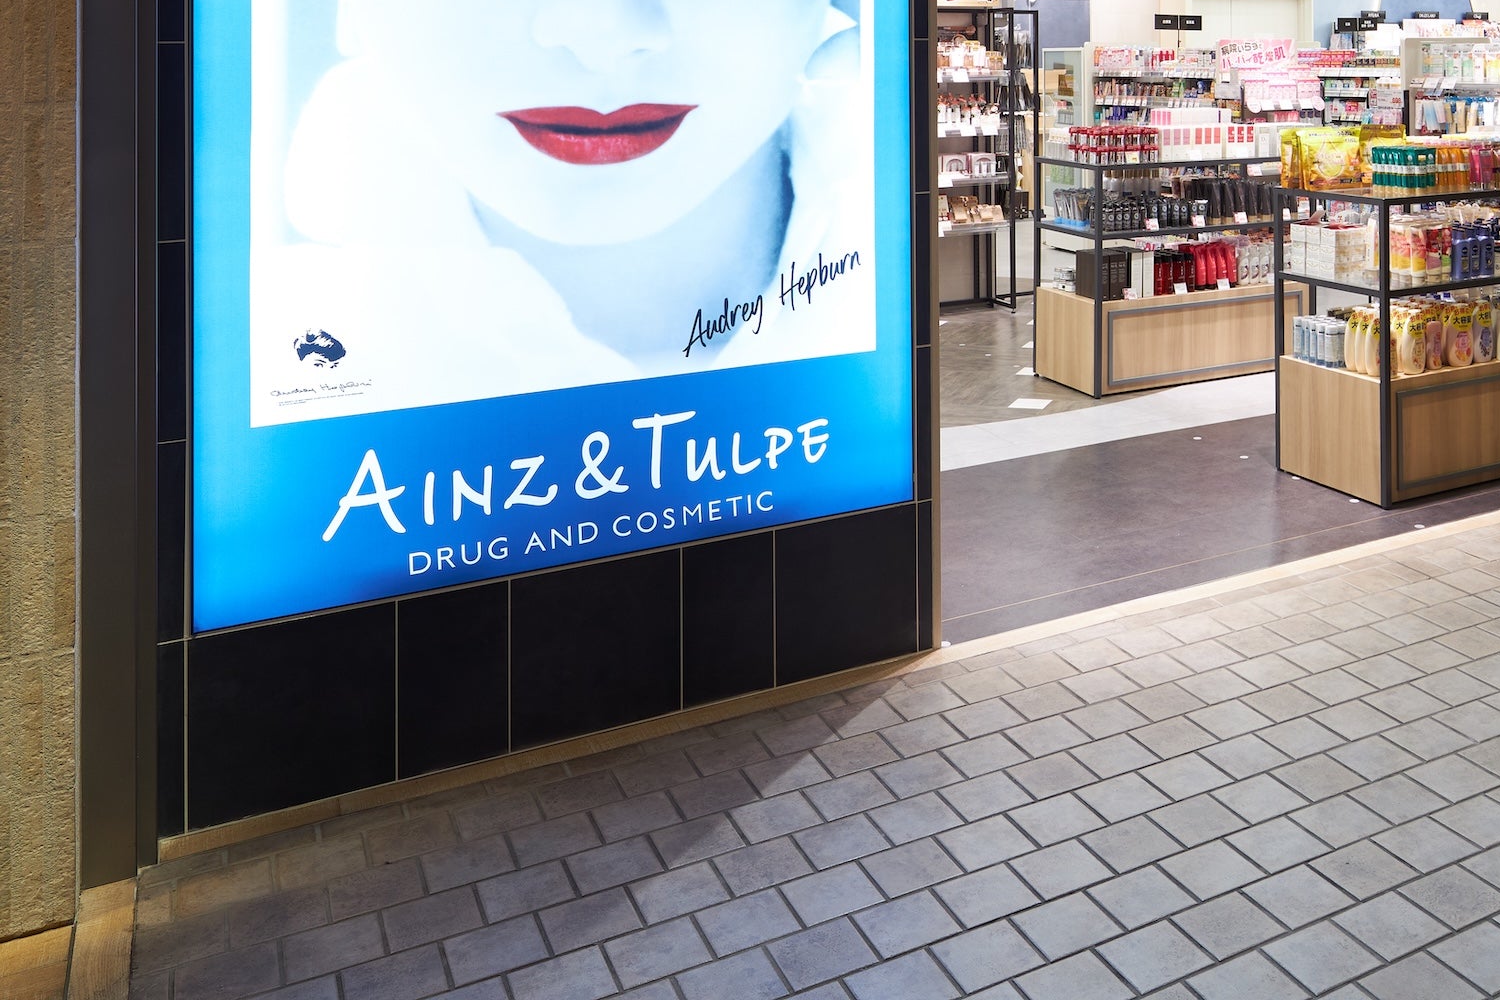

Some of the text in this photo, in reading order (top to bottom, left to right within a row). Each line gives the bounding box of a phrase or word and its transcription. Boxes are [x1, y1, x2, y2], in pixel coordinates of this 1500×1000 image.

[683, 249, 861, 358] Audrey Hepburn
[322, 410, 830, 542] AINZ & TULPE
[408, 490, 775, 576] DRUG AND COSMETIC
